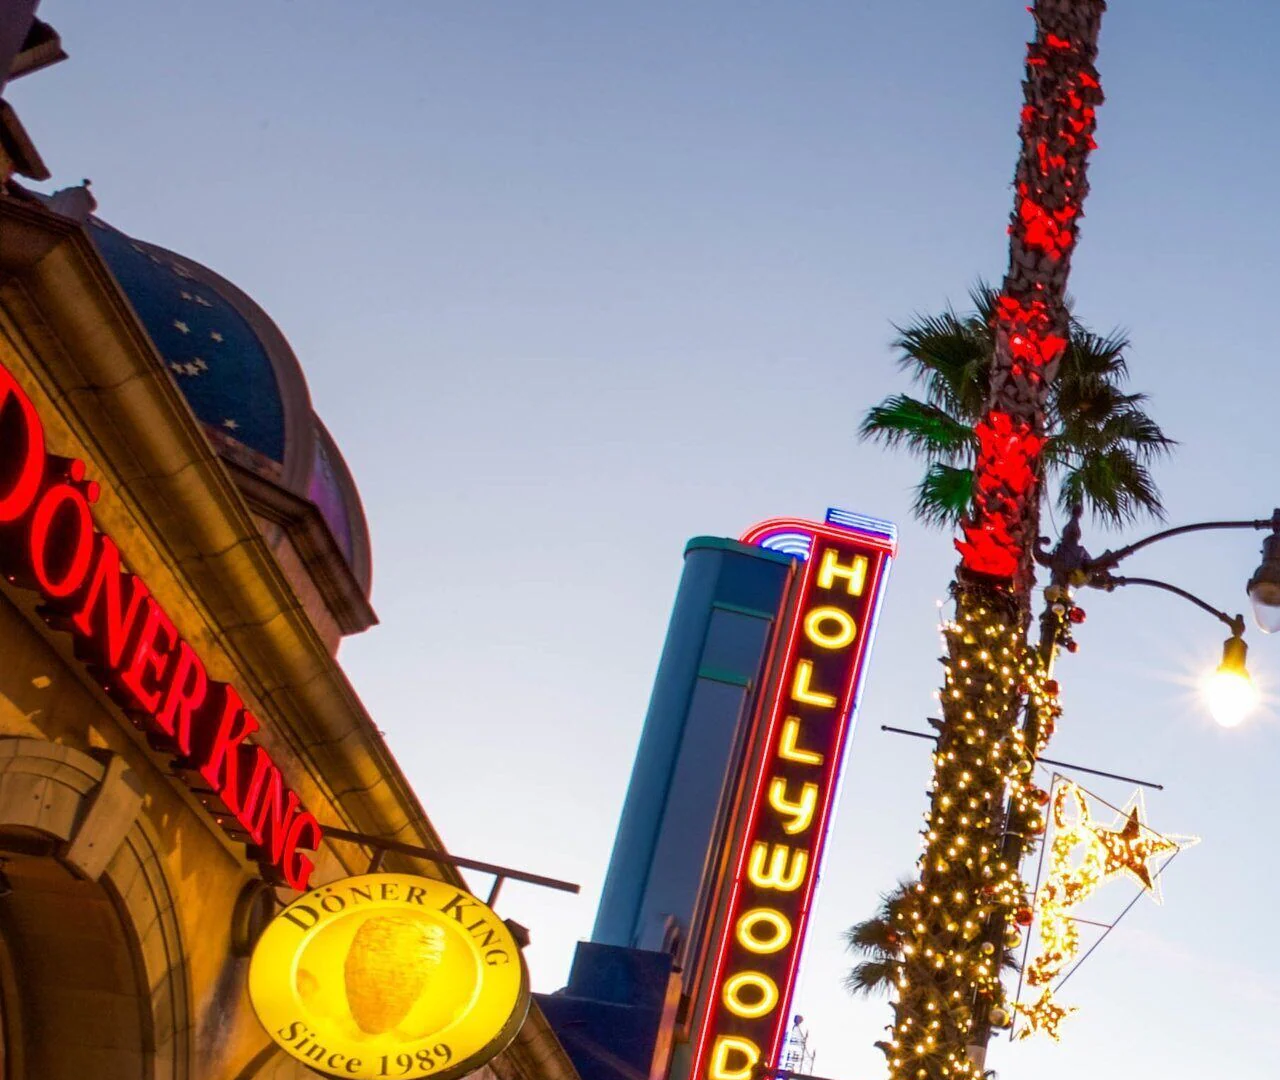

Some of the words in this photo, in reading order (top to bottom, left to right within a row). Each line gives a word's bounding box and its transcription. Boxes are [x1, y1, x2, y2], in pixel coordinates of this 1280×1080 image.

[200, 684, 324, 892] KING
[277, 882, 430, 935] DÖNER
[443, 892, 513, 970] KING
[276, 1018, 364, 1077] Since
[375, 1040, 454, 1077] 1989
